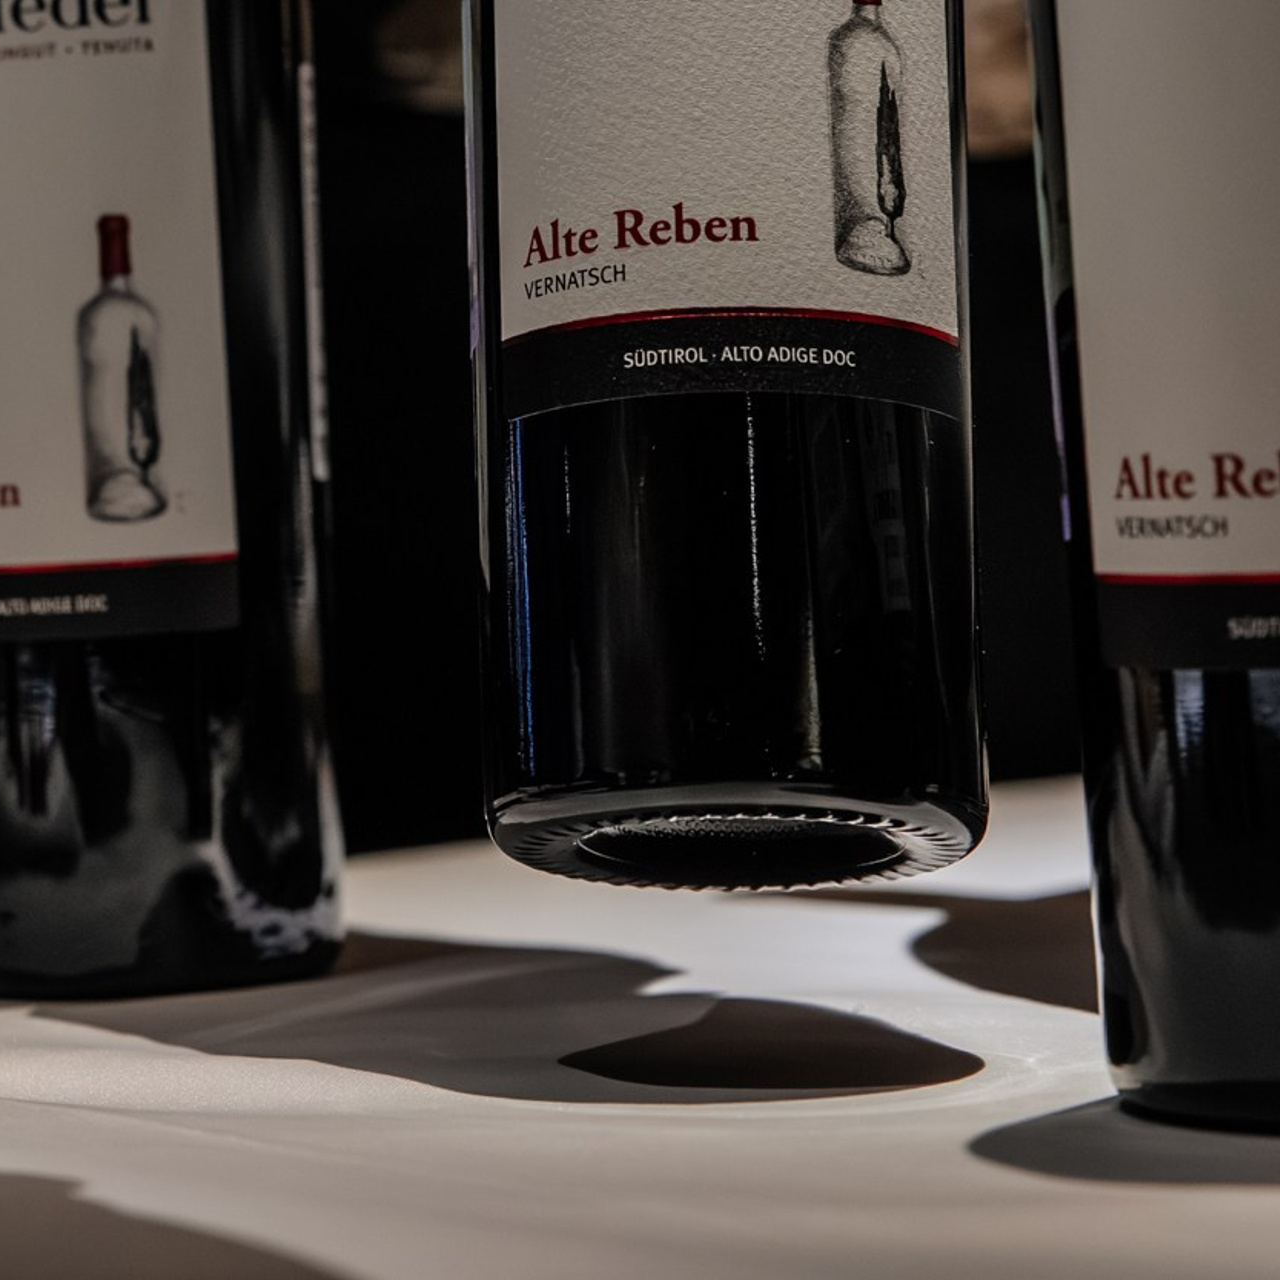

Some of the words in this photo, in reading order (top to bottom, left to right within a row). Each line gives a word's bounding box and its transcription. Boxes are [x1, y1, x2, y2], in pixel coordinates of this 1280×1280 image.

[522, 218, 600, 268] Alte
[613, 202, 759, 250] Reben
[524, 263, 627, 300] VERNATSCH
[623, 348, 709, 369] SÜDTIROL
[720, 346, 763, 363] ALTO
[767, 347, 819, 364] ADIGE
[822, 349, 857, 367] DOC
[1114, 453, 1196, 500] Alte
[1211, 449, 1280, 500] Re
